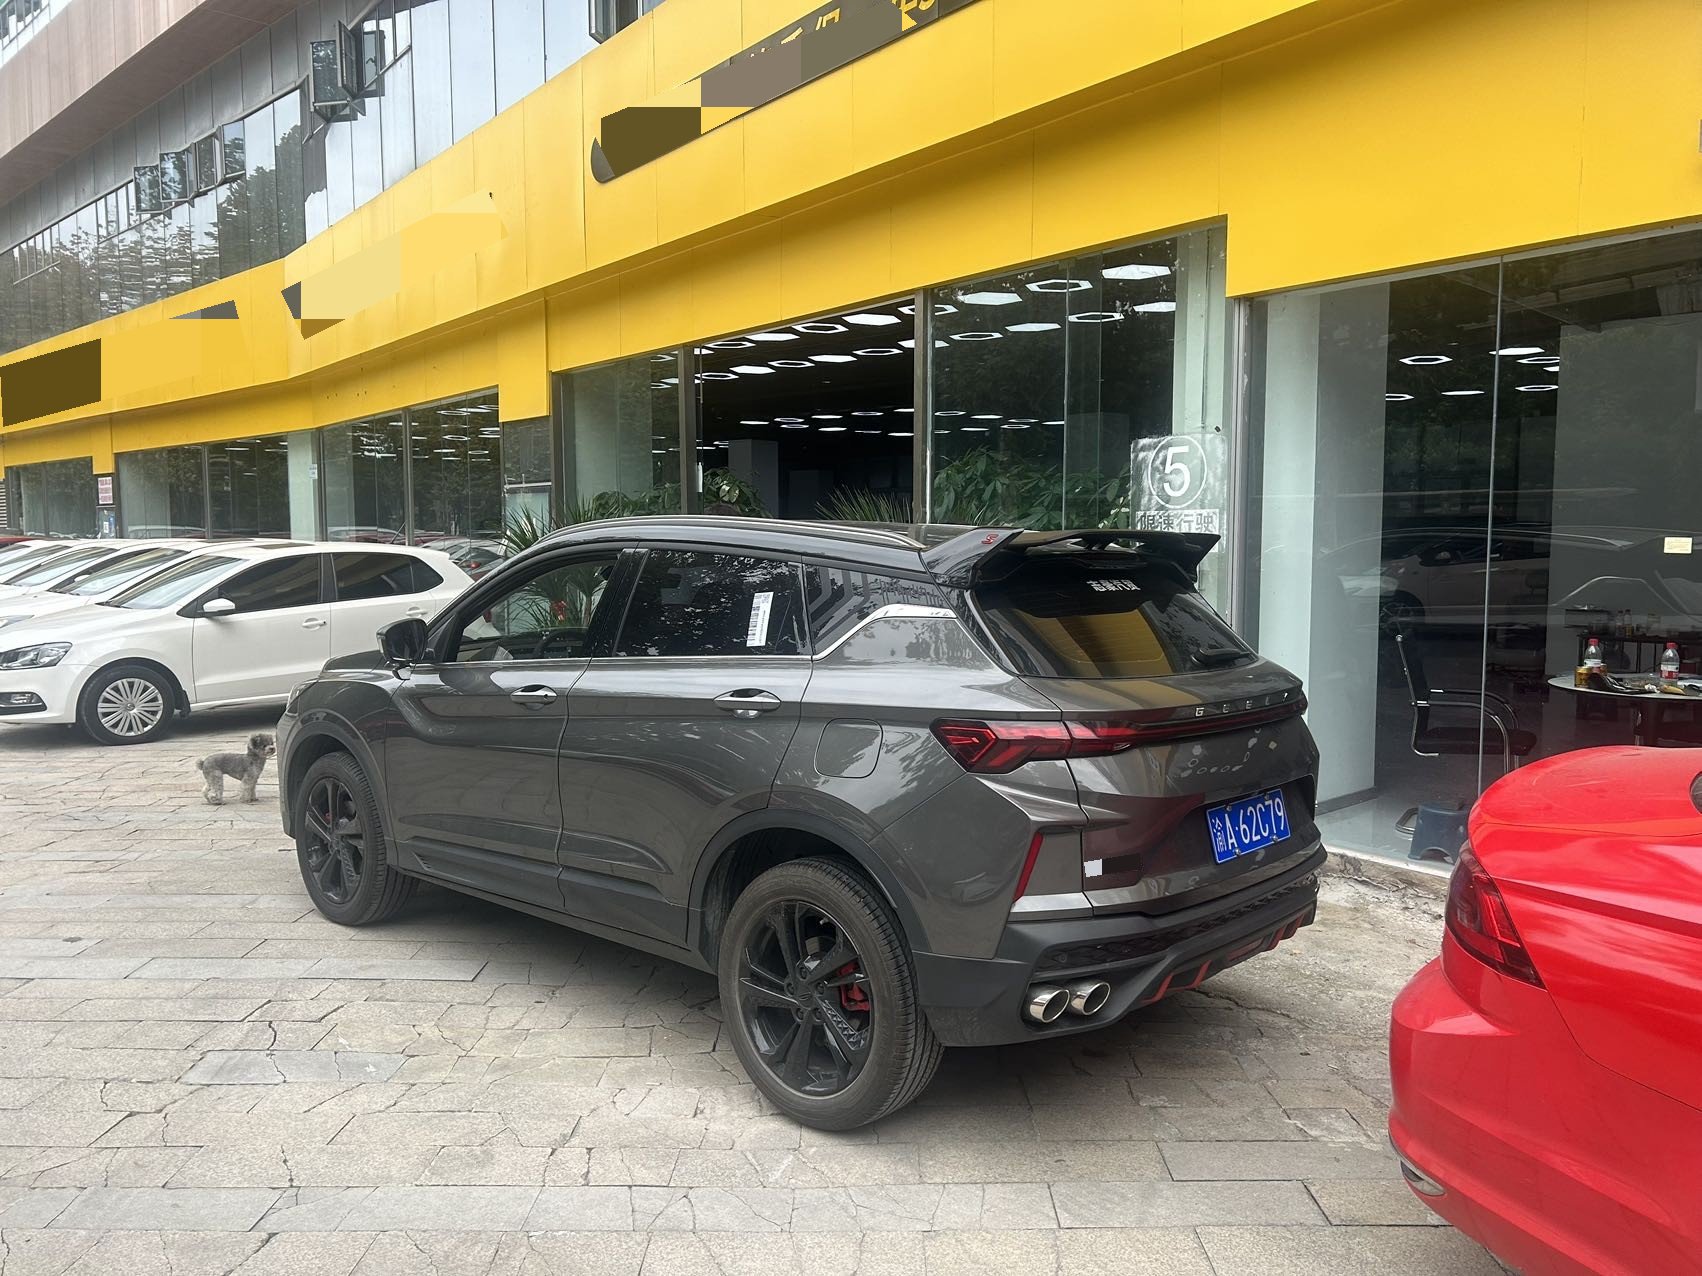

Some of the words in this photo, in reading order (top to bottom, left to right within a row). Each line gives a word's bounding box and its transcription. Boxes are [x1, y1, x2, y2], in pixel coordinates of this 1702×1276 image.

[1163, 446, 1191, 497] 5
[1138, 512, 1214, 533] 限速行驶
